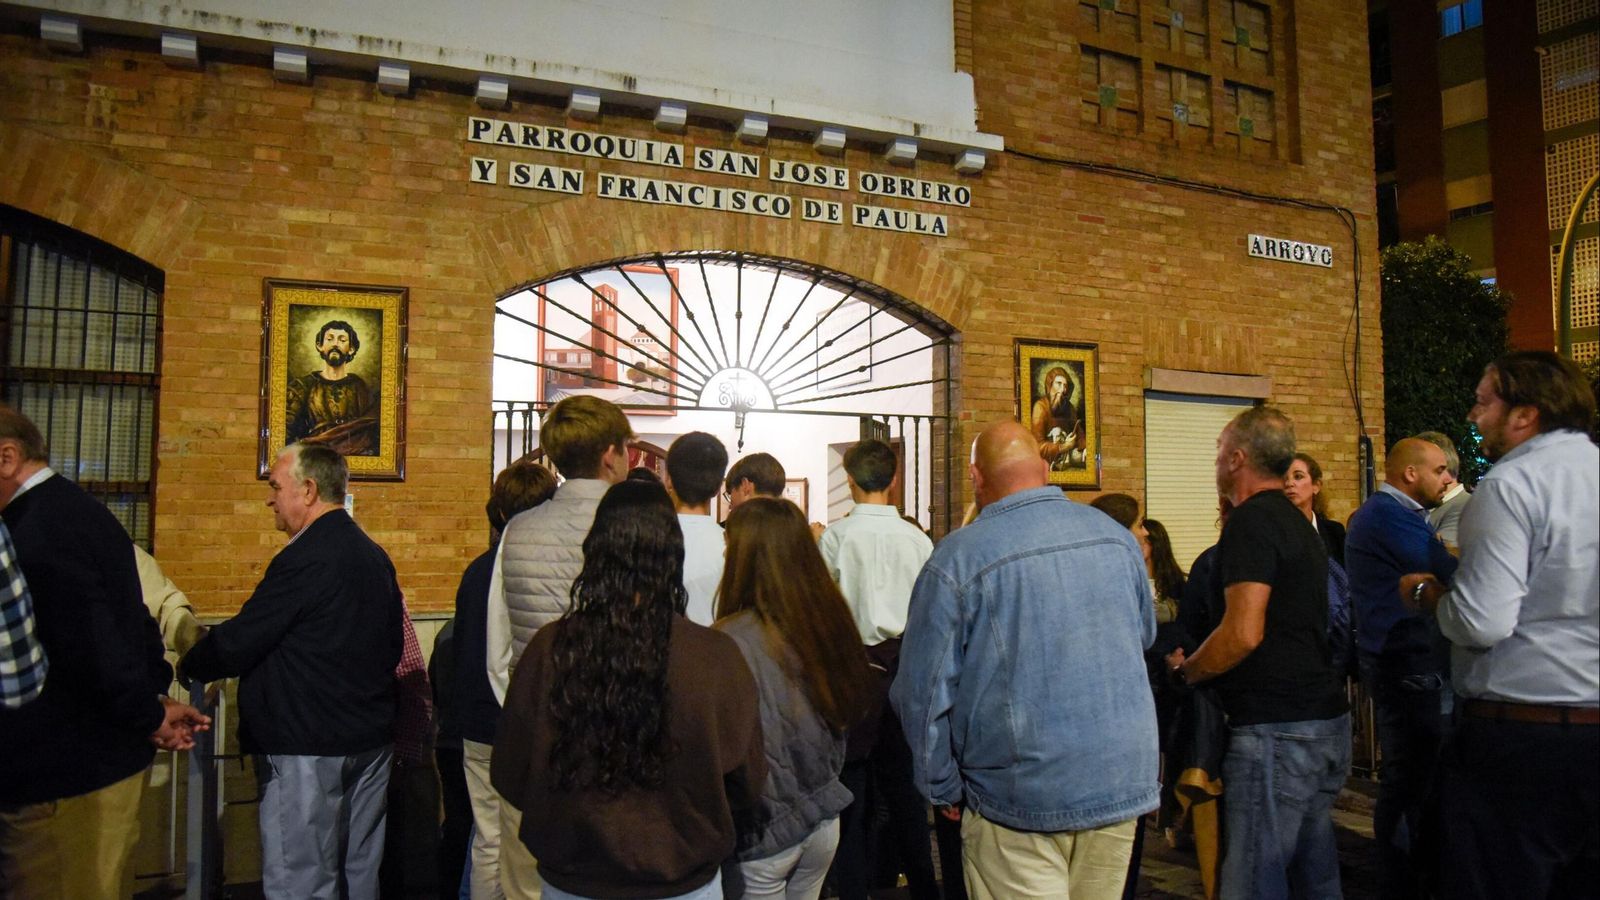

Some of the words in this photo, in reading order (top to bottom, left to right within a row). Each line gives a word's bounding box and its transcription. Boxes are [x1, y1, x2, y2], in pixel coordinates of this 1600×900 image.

[472, 119, 682, 165] PARROQUIA
[699, 150, 758, 176] SAN
[773, 161, 846, 187] JOSE
[861, 173, 970, 205] OBRERO
[475, 160, 494, 181] Y
[514, 164, 581, 192] SAN
[600, 176, 790, 216] FRANCISCO
[804, 203, 839, 221] DE
[855, 207, 946, 234] PAULA
[1251, 237, 1332, 265] ARROYO
